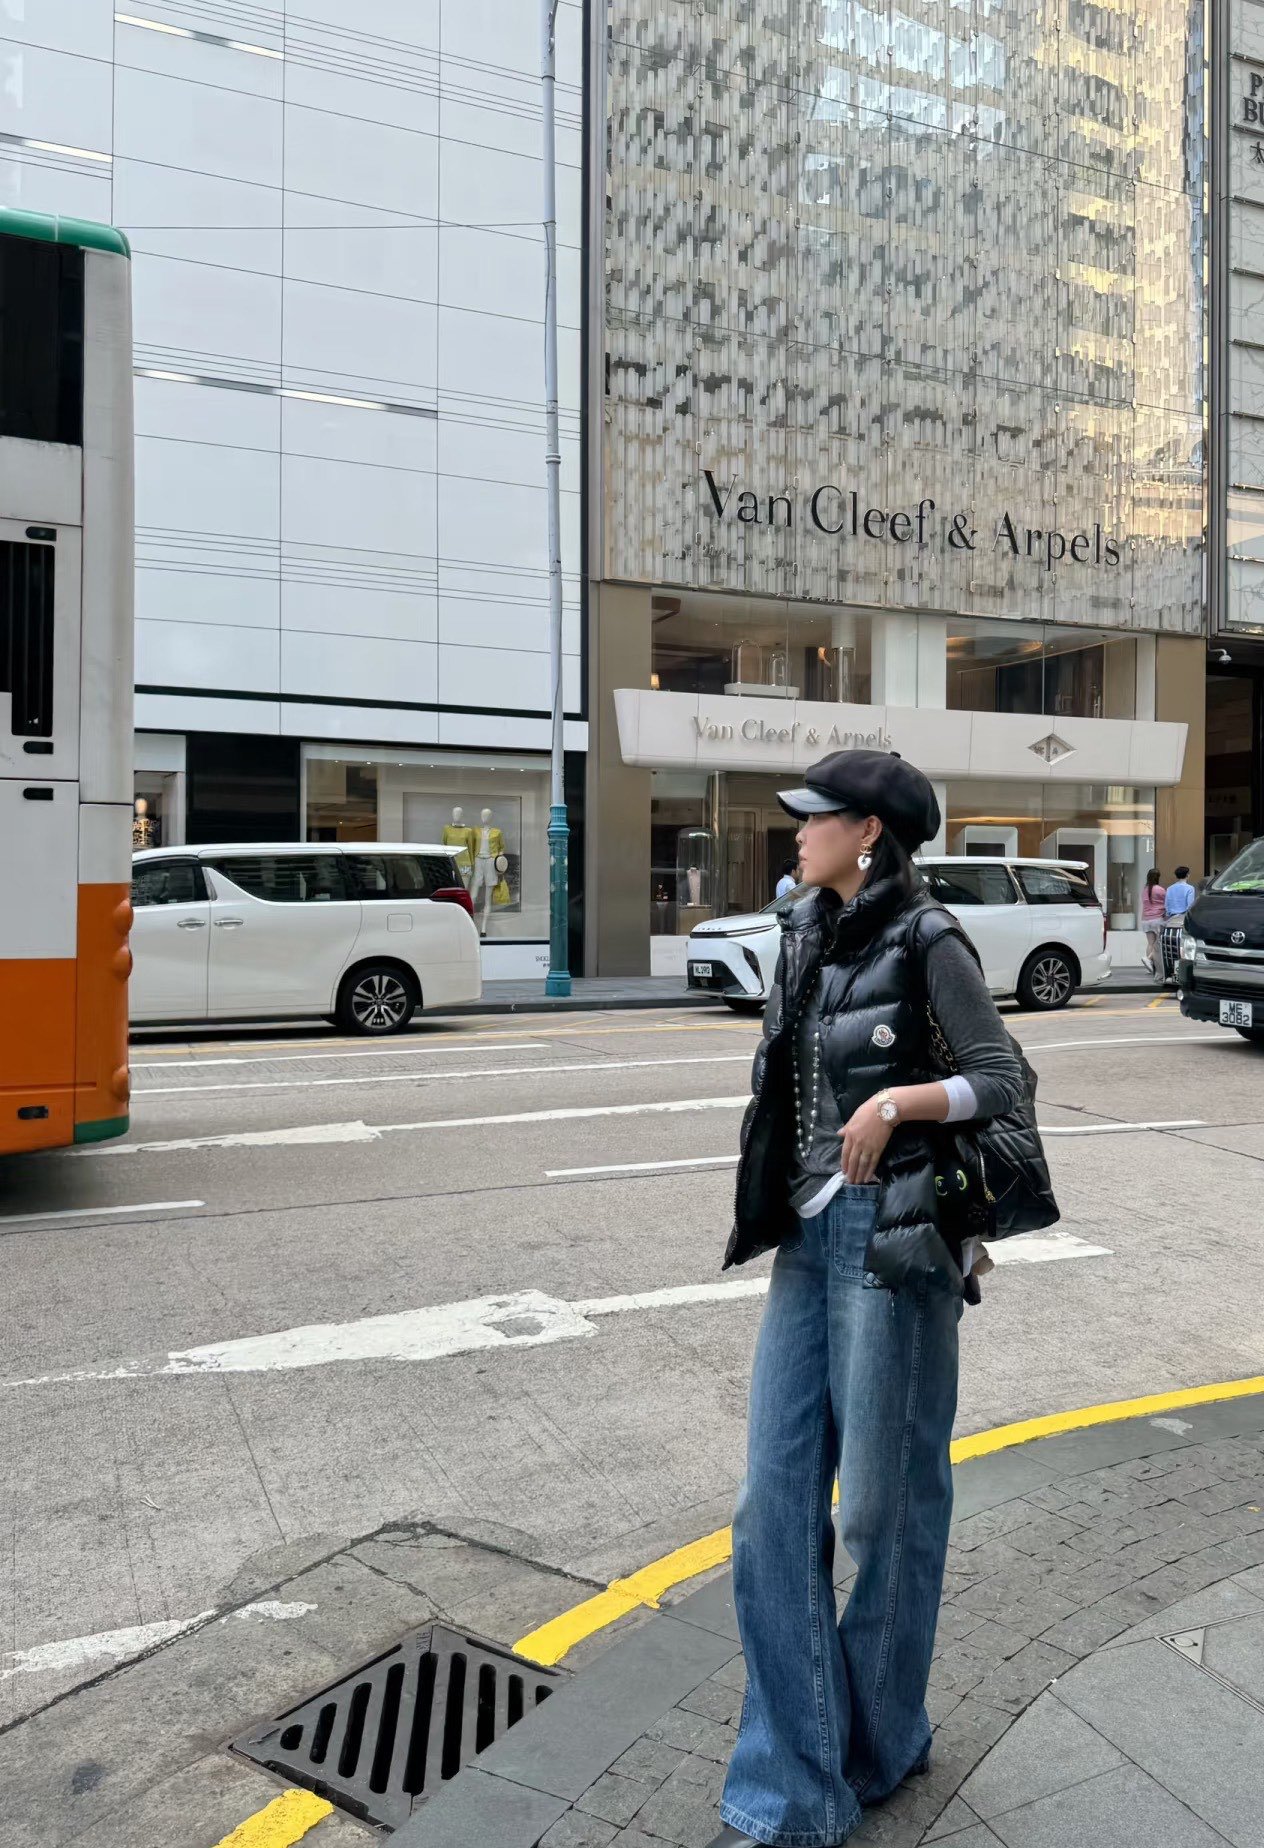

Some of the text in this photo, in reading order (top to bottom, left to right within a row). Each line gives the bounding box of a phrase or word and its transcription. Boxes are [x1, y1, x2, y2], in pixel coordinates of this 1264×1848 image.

[1250, 71, 1264, 97] P
[700, 468, 1120, 571] Van Cleef & Arpels
[692, 716, 892, 750] Van Cleef & Arpels
[1222, 1011, 1250, 1026] 3082
